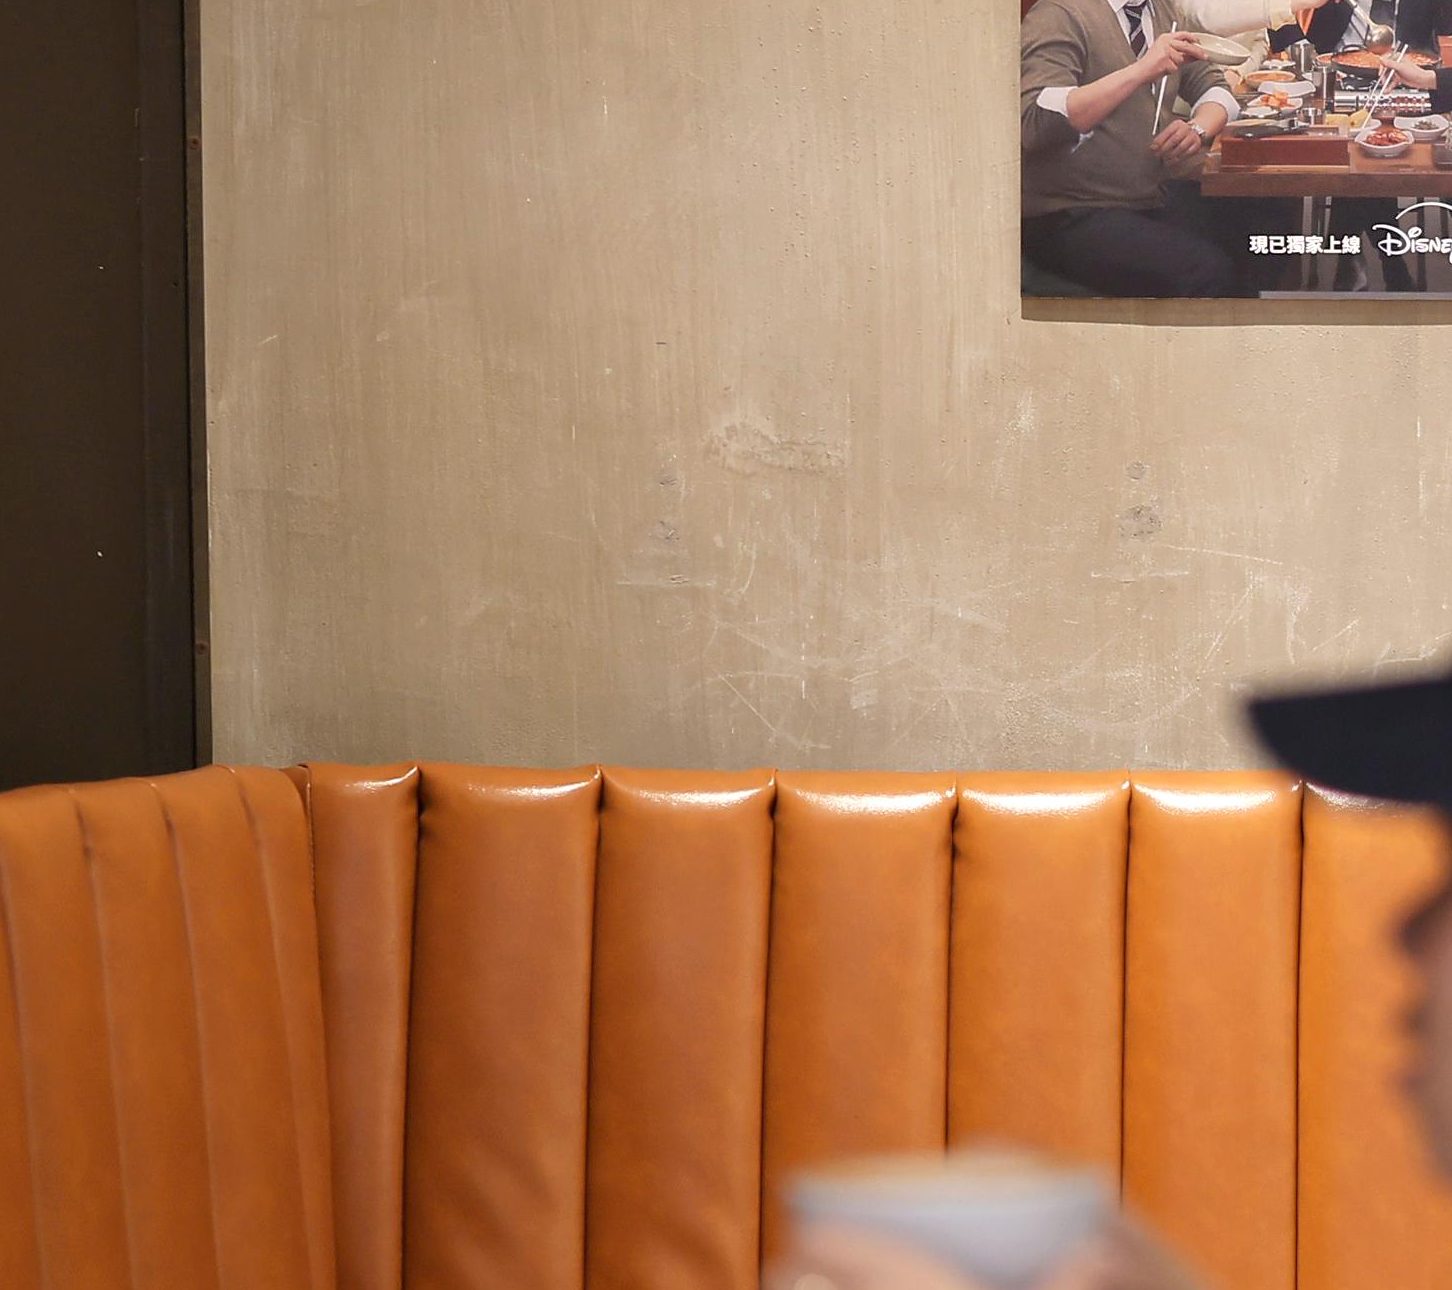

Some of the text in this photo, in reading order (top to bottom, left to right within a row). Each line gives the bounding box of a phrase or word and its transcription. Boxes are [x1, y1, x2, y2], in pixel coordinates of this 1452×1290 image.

[1249, 235, 1361, 254] 現已獨家上線
